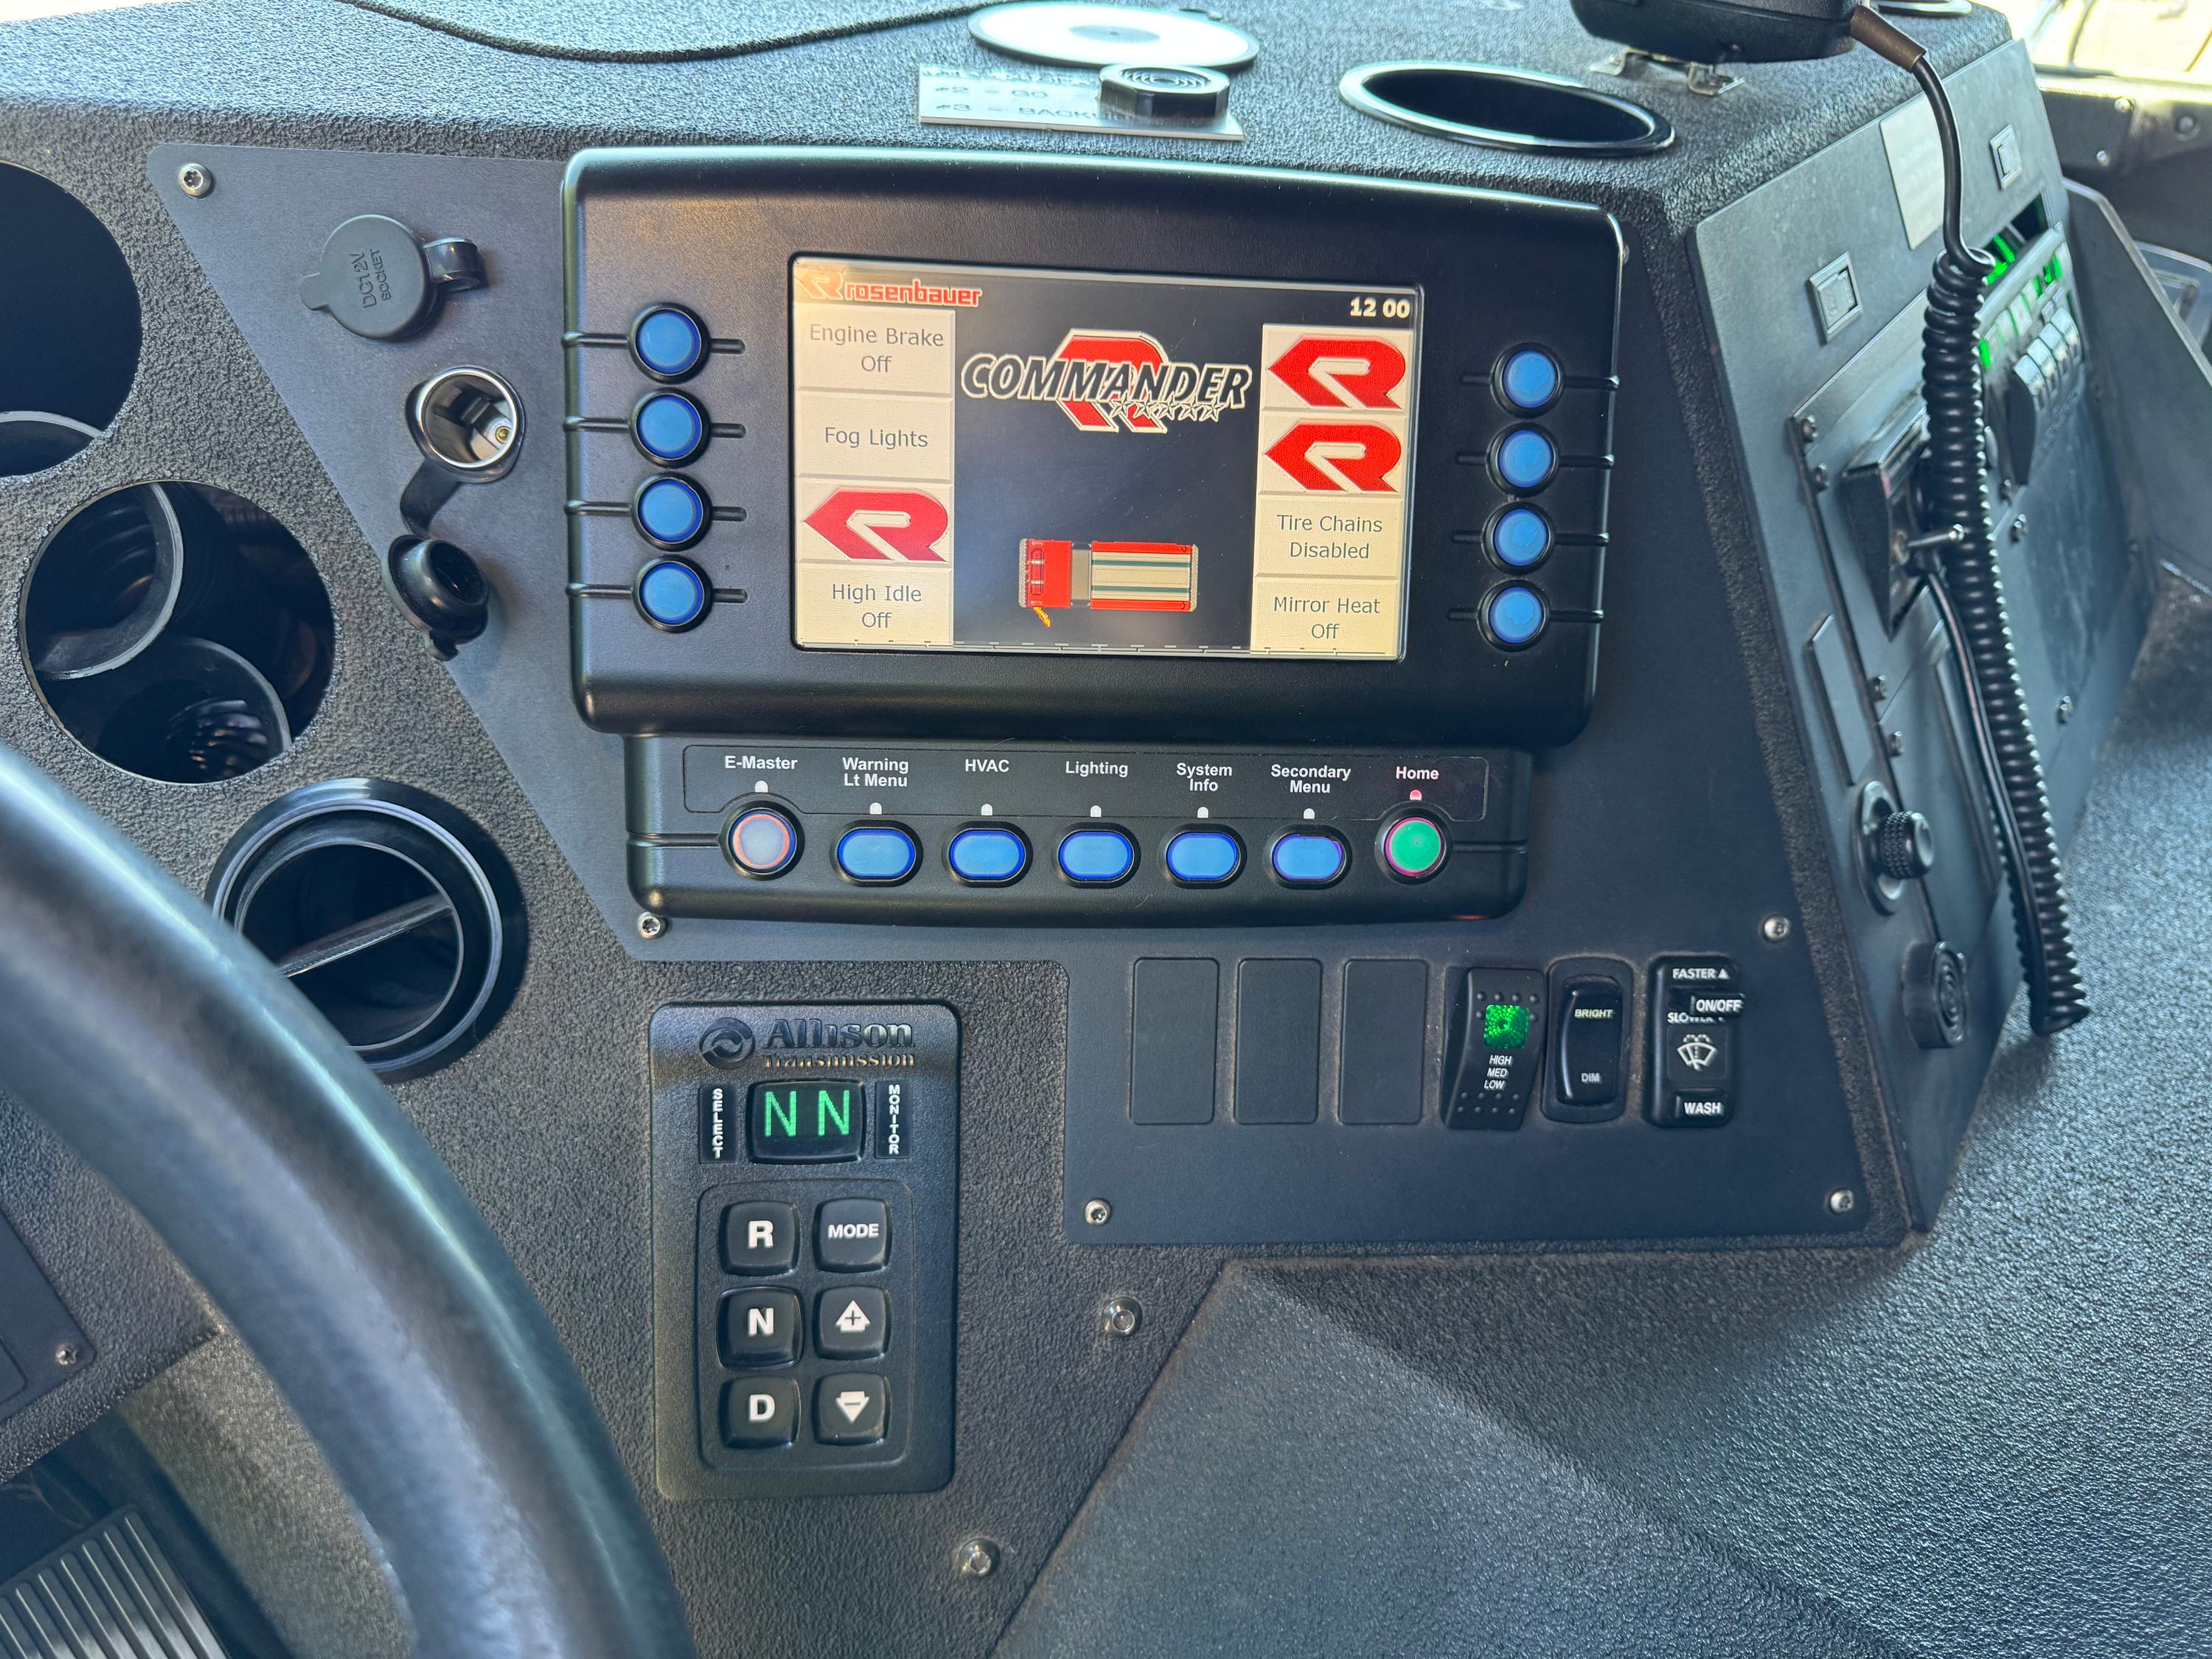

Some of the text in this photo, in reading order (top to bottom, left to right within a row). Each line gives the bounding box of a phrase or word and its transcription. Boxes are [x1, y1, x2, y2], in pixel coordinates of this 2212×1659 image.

[369, 248, 392, 301] SOCKET
[845, 279, 982, 307] rosenbauer
[1350, 296, 1410, 319] 12 00
[810, 324, 944, 347] Engine Brake
[861, 356, 891, 372] Off
[961, 352, 1252, 408] COMMANDER
[824, 426, 928, 450] Fog Lights
[1276, 514, 1382, 533] Tire Chains
[1290, 542, 1369, 560] Disabled
[832, 584, 922, 604] High Idle
[1274, 597, 1380, 614] Mirror Heat
[862, 612, 891, 628] Off
[1311, 623, 1339, 640] Off
[725, 756, 798, 771] E-Master
[842, 757, 909, 775] Warning
[965, 759, 1009, 773] HVAC
[1065, 761, 1128, 777] Lighting
[1176, 762, 1232, 778] System
[844, 773, 908, 787] Lt Menu
[1271, 765, 1351, 782] Secondary
[1396, 767, 1439, 781] Home
[1189, 779, 1219, 792] Info
[1290, 780, 1330, 793] Menu
[1672, 968, 1717, 979] FASTER
[1696, 999, 1743, 1012] ON/OFF
[1575, 1009, 1615, 1019] BRIGHT
[762, 1019, 916, 1048] Allison
[762, 1053, 915, 1068] Transmission
[1489, 1054, 1512, 1066] HIGH
[1487, 1067, 1508, 1078] MED
[1581, 1072, 1601, 1084] DIM
[1484, 1079, 1505, 1091] LOW
[1684, 1102, 1723, 1115] WASH
[712, 1088, 724, 1159] SELECT
[888, 1084, 900, 1155] MONITOR
[748, 1220, 774, 1249] R
[828, 1223, 880, 1239] MODE
[748, 1307, 774, 1338] N
[749, 1394, 776, 1423] D
